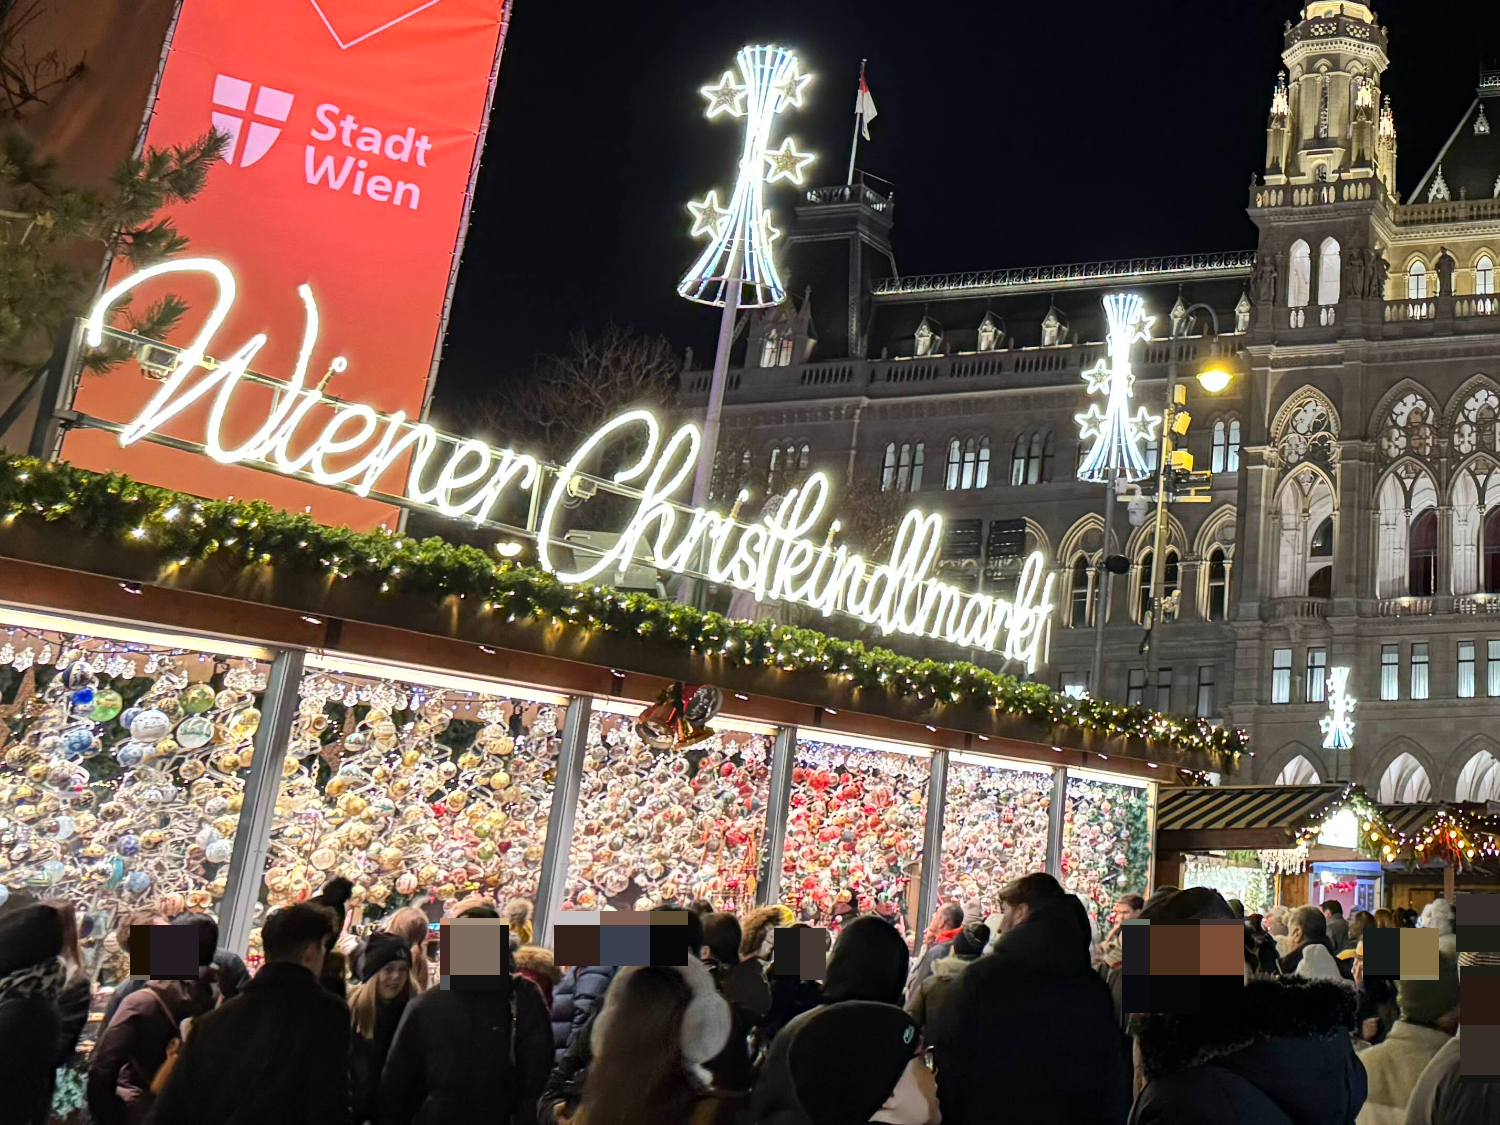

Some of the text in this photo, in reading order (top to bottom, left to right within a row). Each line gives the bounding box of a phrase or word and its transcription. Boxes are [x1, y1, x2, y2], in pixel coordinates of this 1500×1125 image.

[310, 103, 433, 168] Stadt
[304, 145, 421, 210] Wien
[87, 257, 1055, 675] Wiener Christkindlmarkt
